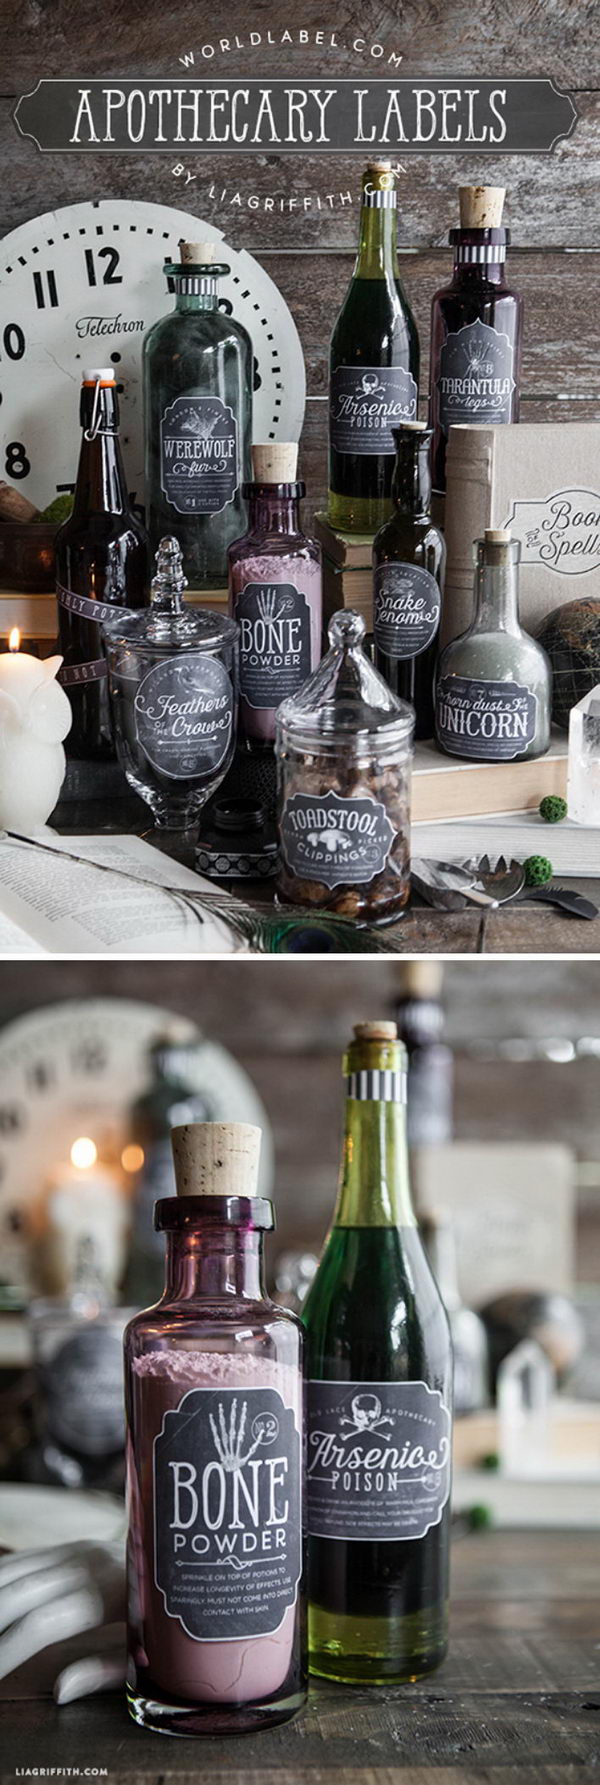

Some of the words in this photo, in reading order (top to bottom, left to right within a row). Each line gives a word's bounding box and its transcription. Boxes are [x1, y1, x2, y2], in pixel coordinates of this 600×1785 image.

[84, 246, 123, 287] 12
[33, 270, 59, 309] 11
[75, 313, 146, 339] Telechron
[2, 323, 25, 361] 0
[440, 377, 511, 395] TARANTULA
[334, 394, 417, 419] Arsenic
[448, 395, 502, 413] legs
[350, 415, 388, 428] POISON
[5, 442, 31, 480] 8
[164, 440, 236, 459] WEREWOLF
[375, 588, 426, 610] Snake
[240, 617, 302, 654] BONE
[241, 654, 301, 666] POWDER
[134, 694, 229, 720] Feathers
[472, 697, 520, 712] dust
[440, 702, 529, 738] UNICORN
[289, 809, 378, 836] TOADSTOOL
[297, 842, 367, 864] CLIPPINGS
[307, 1431, 450, 1473] Arsenic
[331, 1471, 398, 1492] POISON
[168, 1457, 289, 1531] BONE
[174, 1528, 287, 1554] POWDER
[181, 1573, 213, 1581] SPRINKLE
[214, 1573, 226, 1581] ON
[227, 1572, 241, 1580] TOP
[241, 1571, 251, 1579] OF
[252, 1569, 278, 1578] POTIONS
[278, 1566, 286, 1574] TO
[206, 1584, 245, 1593] LONGEVITY
[245, 1583, 255, 1591] OF
[207, 1597, 226, 1605] MUST
[227, 1596, 242, 1604] NOT
[242, 1593, 262, 1603] COME
[262, 1591, 277, 1600] INTO
[202, 1608, 235, 1617] CONTACT
[235, 1606, 253, 1615] WITH
